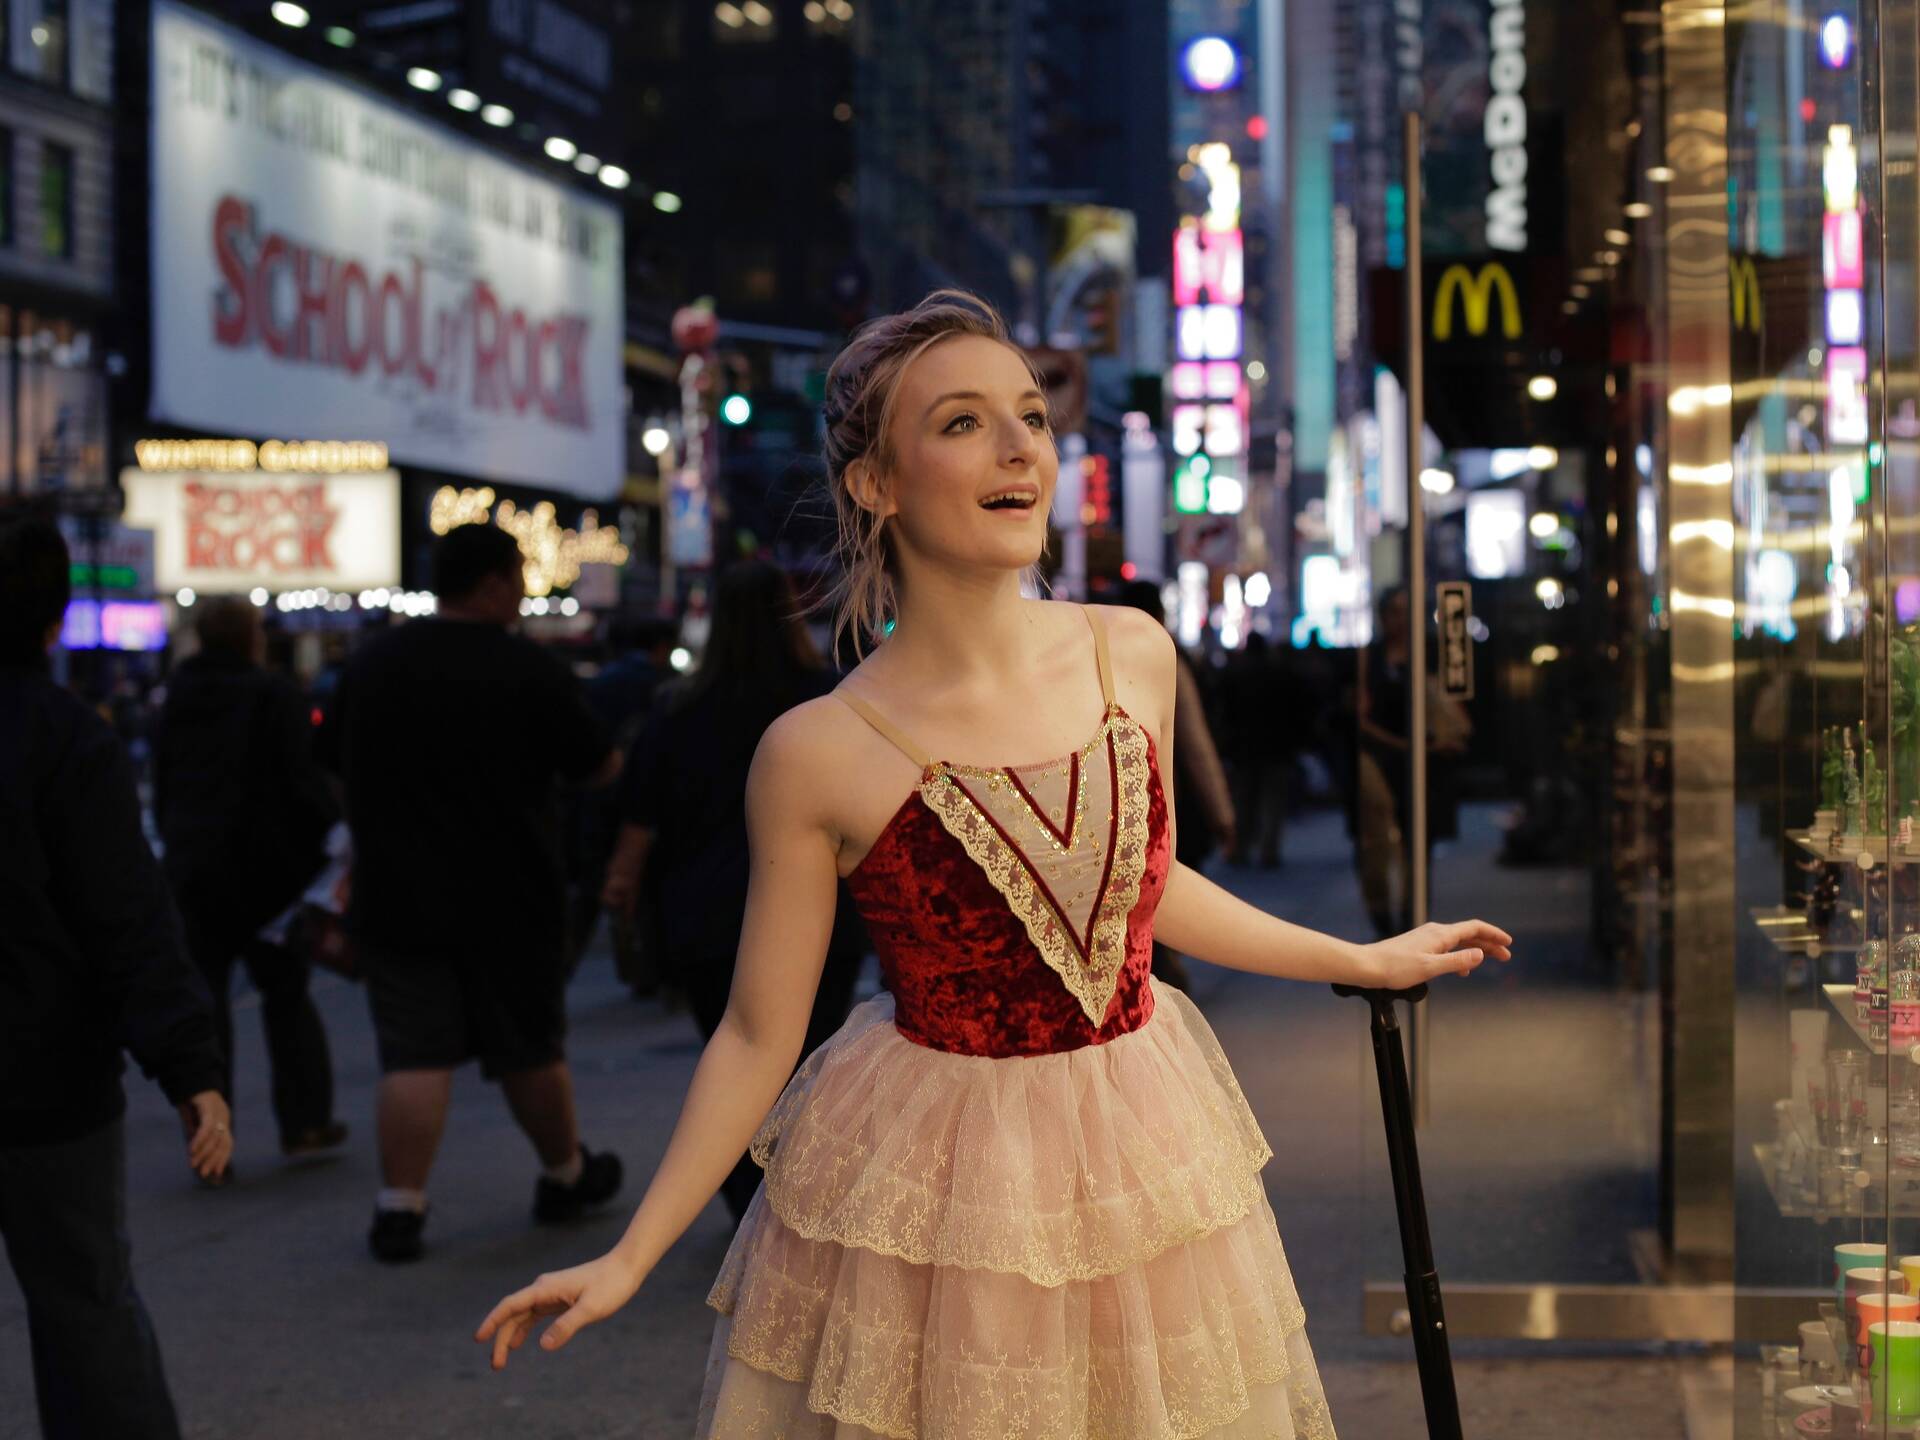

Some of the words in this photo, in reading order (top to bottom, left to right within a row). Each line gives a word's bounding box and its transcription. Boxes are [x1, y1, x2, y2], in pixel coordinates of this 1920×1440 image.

[1484, 0, 1529, 251] McDon
[213, 195, 437, 390] SCHOOL
[472, 279, 592, 431] ROCK
[185, 511, 340, 571] ROCK
[1444, 592, 1465, 687] PUSH
